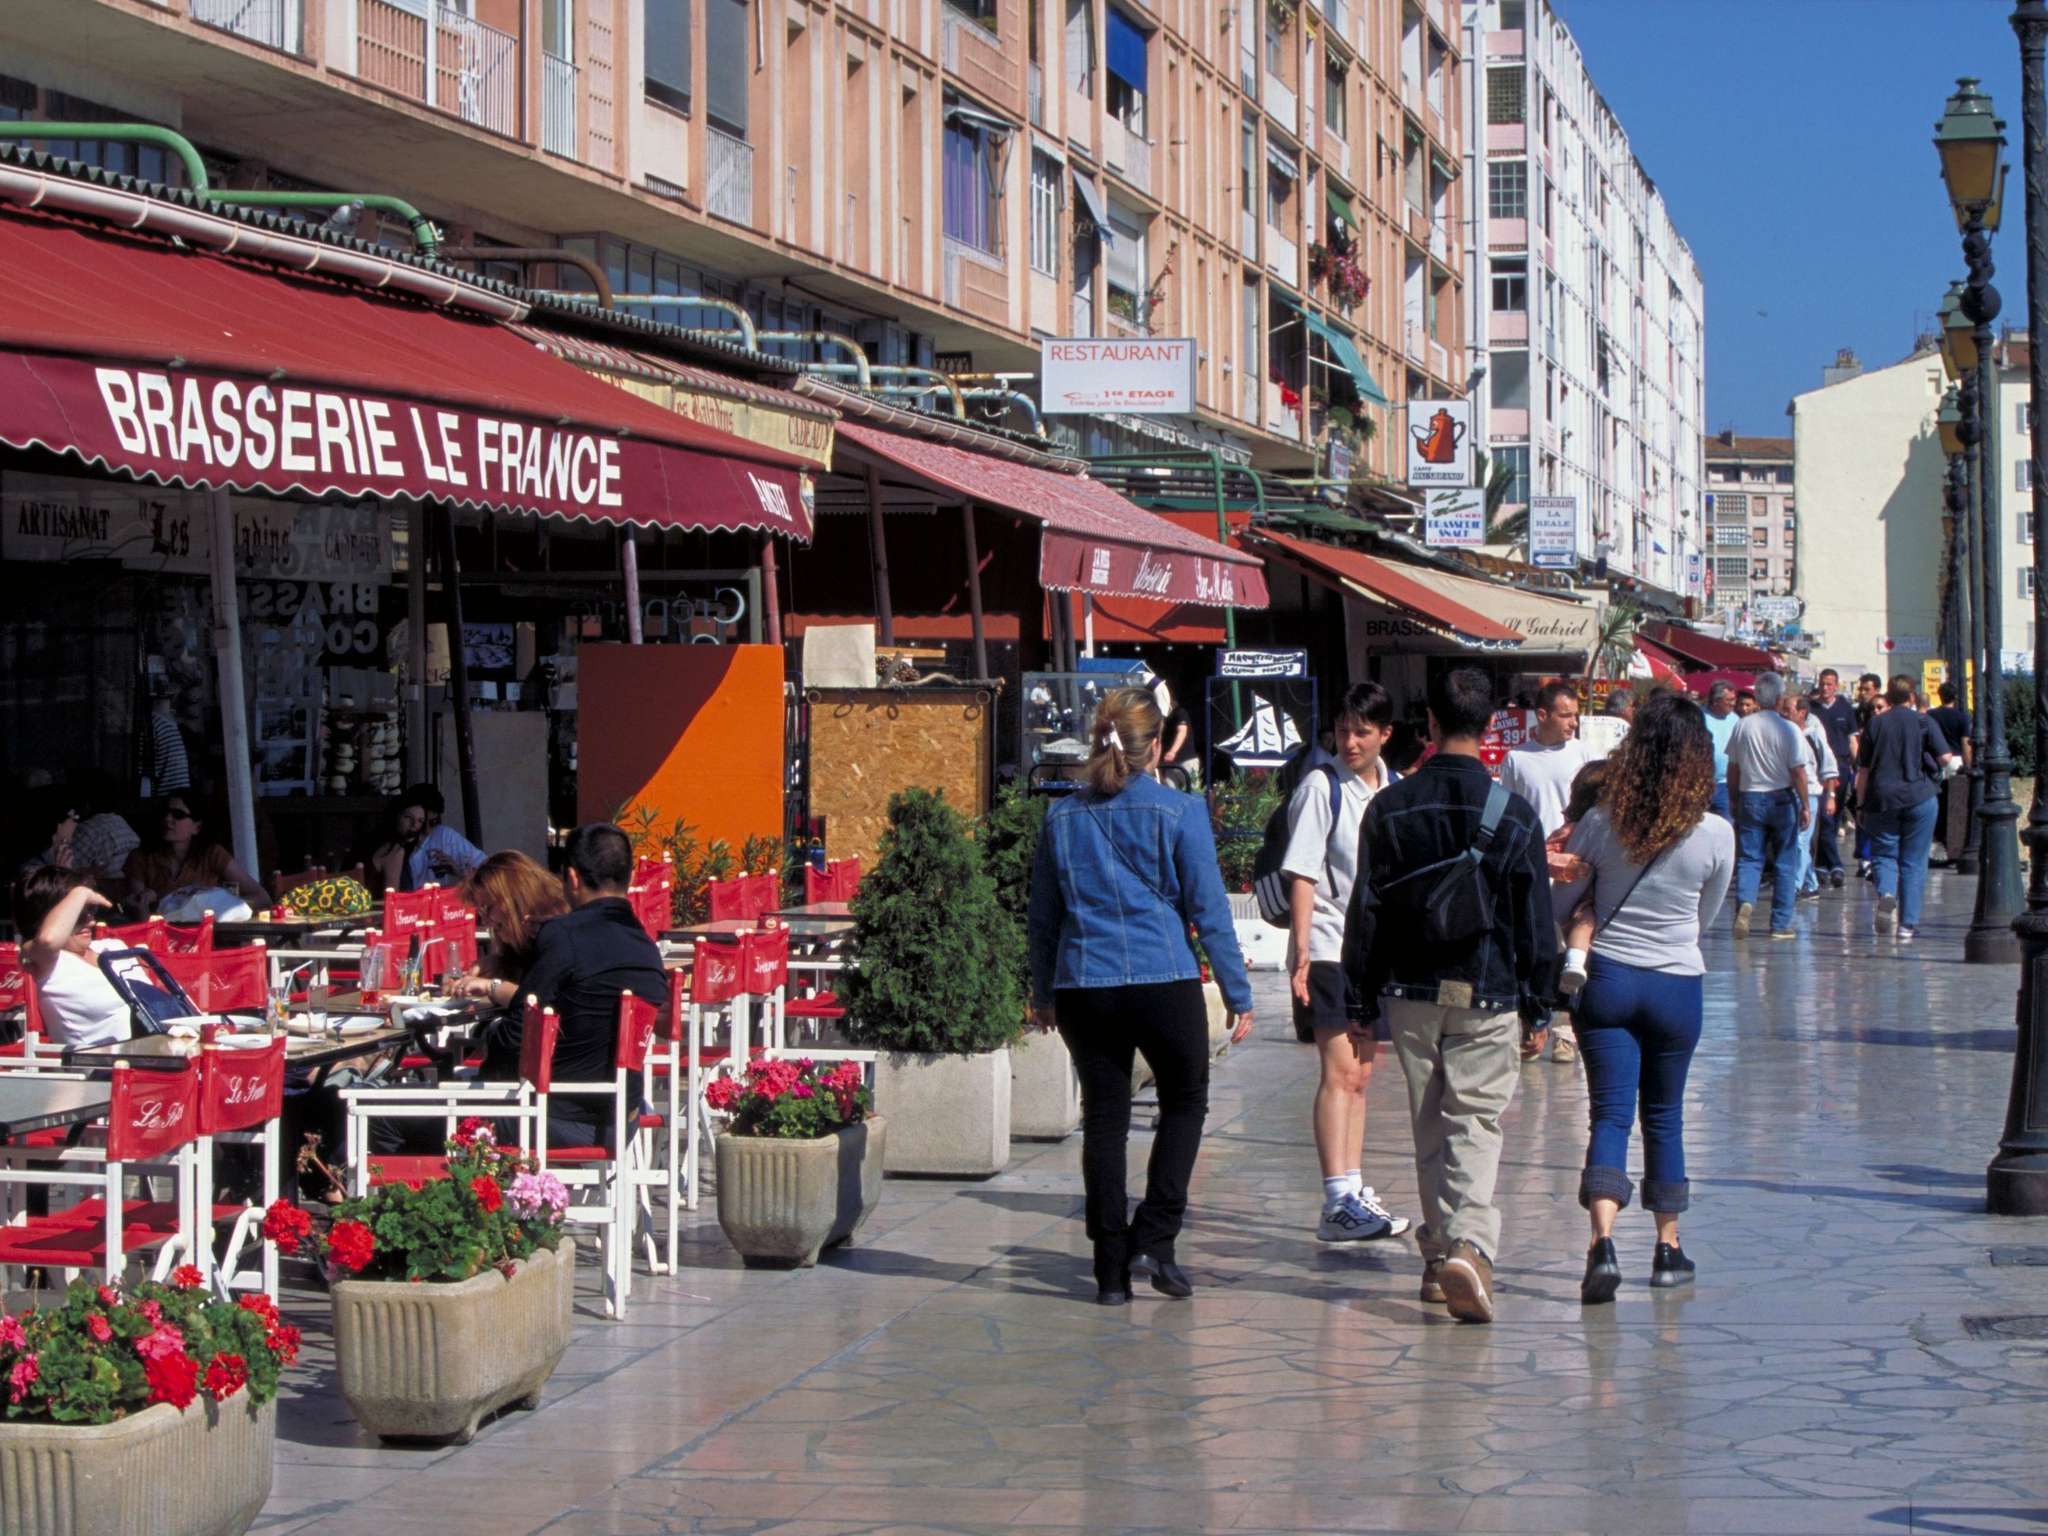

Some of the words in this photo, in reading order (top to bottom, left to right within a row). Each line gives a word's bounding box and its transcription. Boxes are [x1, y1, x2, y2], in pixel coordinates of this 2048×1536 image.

[1051, 345, 1184, 361] RESTAURANT
[95, 367, 405, 478] BRASSERIE
[410, 407, 468, 486] LE
[476, 418, 623, 506] FRANCE
[748, 471, 793, 522] AMSTEL
[17, 501, 110, 540] ARTISANAT
[1526, 615, 1589, 637] Gabriel
[224, 1076, 242, 1104] Le
[132, 1100, 162, 1129] Le
